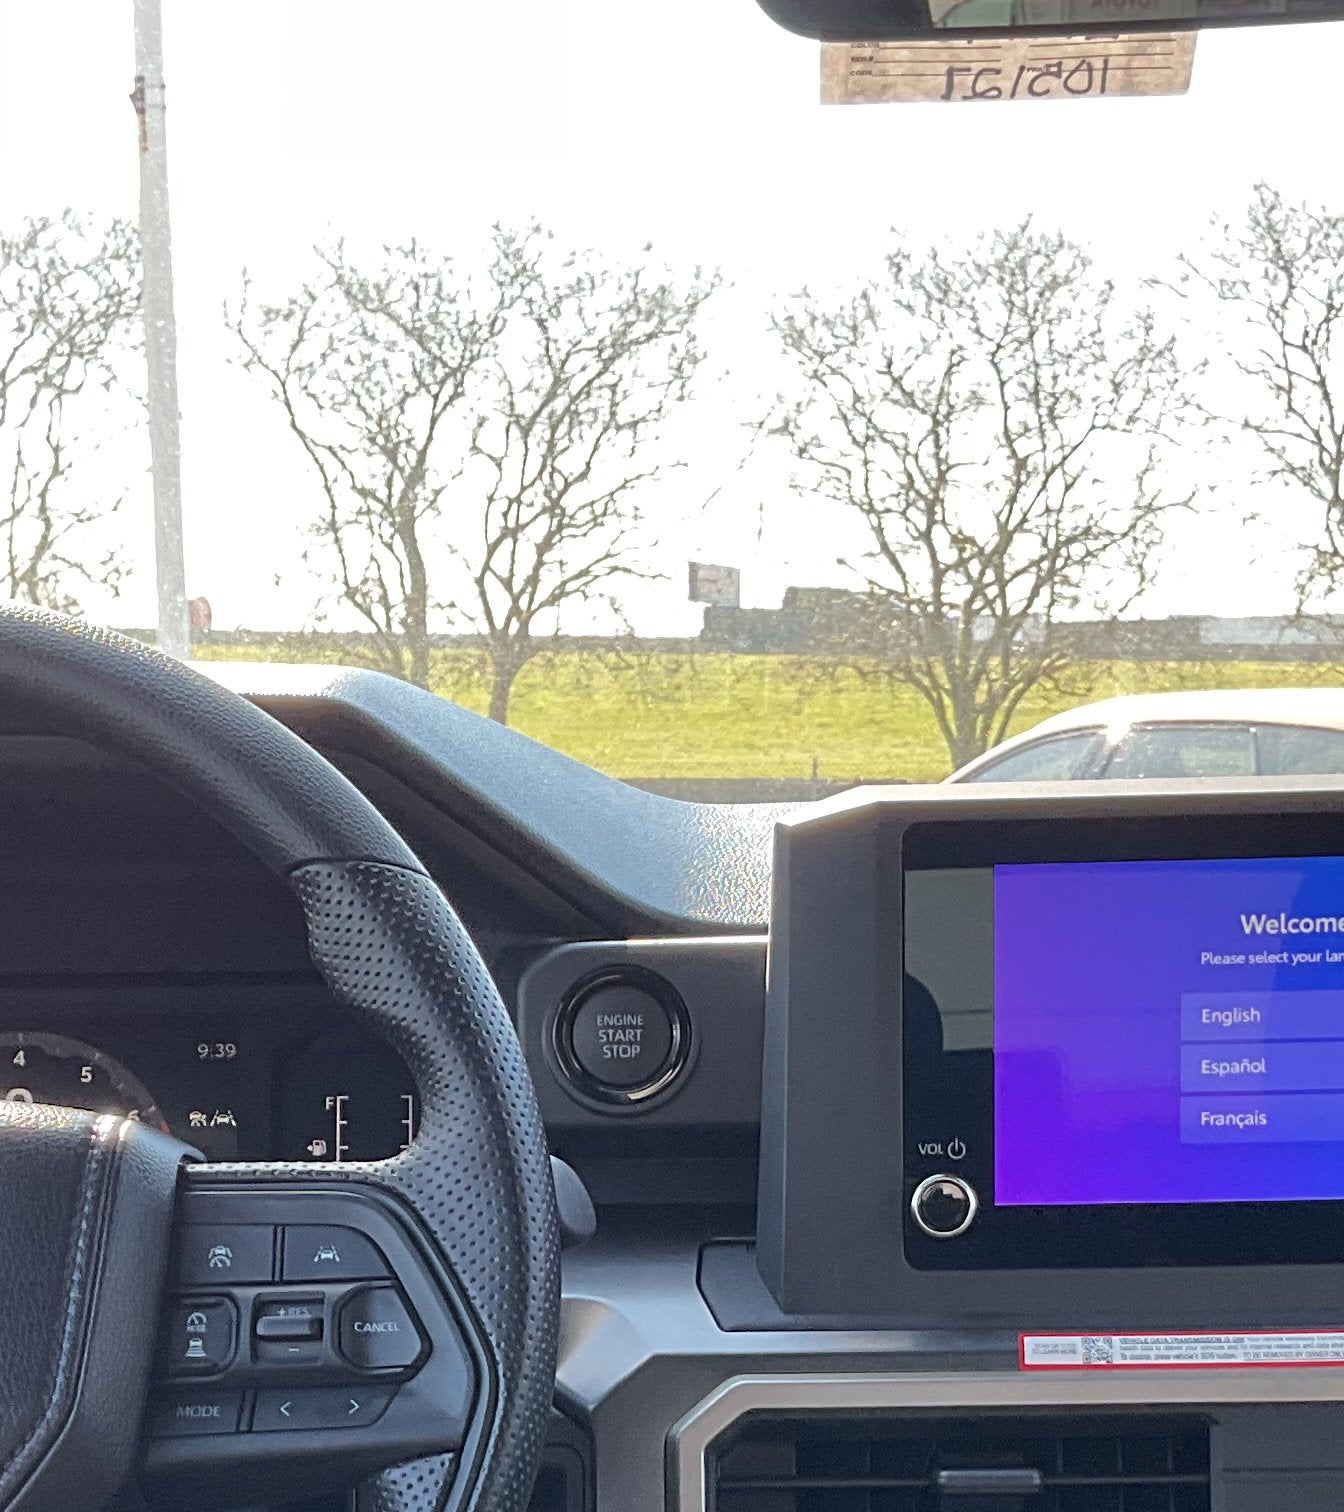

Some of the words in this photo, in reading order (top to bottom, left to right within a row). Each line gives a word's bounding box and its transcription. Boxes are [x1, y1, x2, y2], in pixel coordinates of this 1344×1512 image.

[1200, 950, 1244, 966] Please
[1248, 950, 1288, 966] select
[1291, 952, 1322, 967] your
[596, 1014, 644, 1026] ENGINE
[1201, 1006, 1262, 1027] English
[598, 1029, 644, 1043] START
[12, 1050, 26, 1067] 4
[197, 1043, 237, 1059] 9:39
[602, 1045, 641, 1059] STOP
[79, 1066, 93, 1083] 5
[1200, 1057, 1267, 1078] Español
[325, 1096, 336, 1110] F
[1200, 1108, 1268, 1131] Français
[917, 1142, 943, 1156] VOL
[354, 1321, 400, 1333] CANCEL
[175, 1405, 221, 1418] MODE
